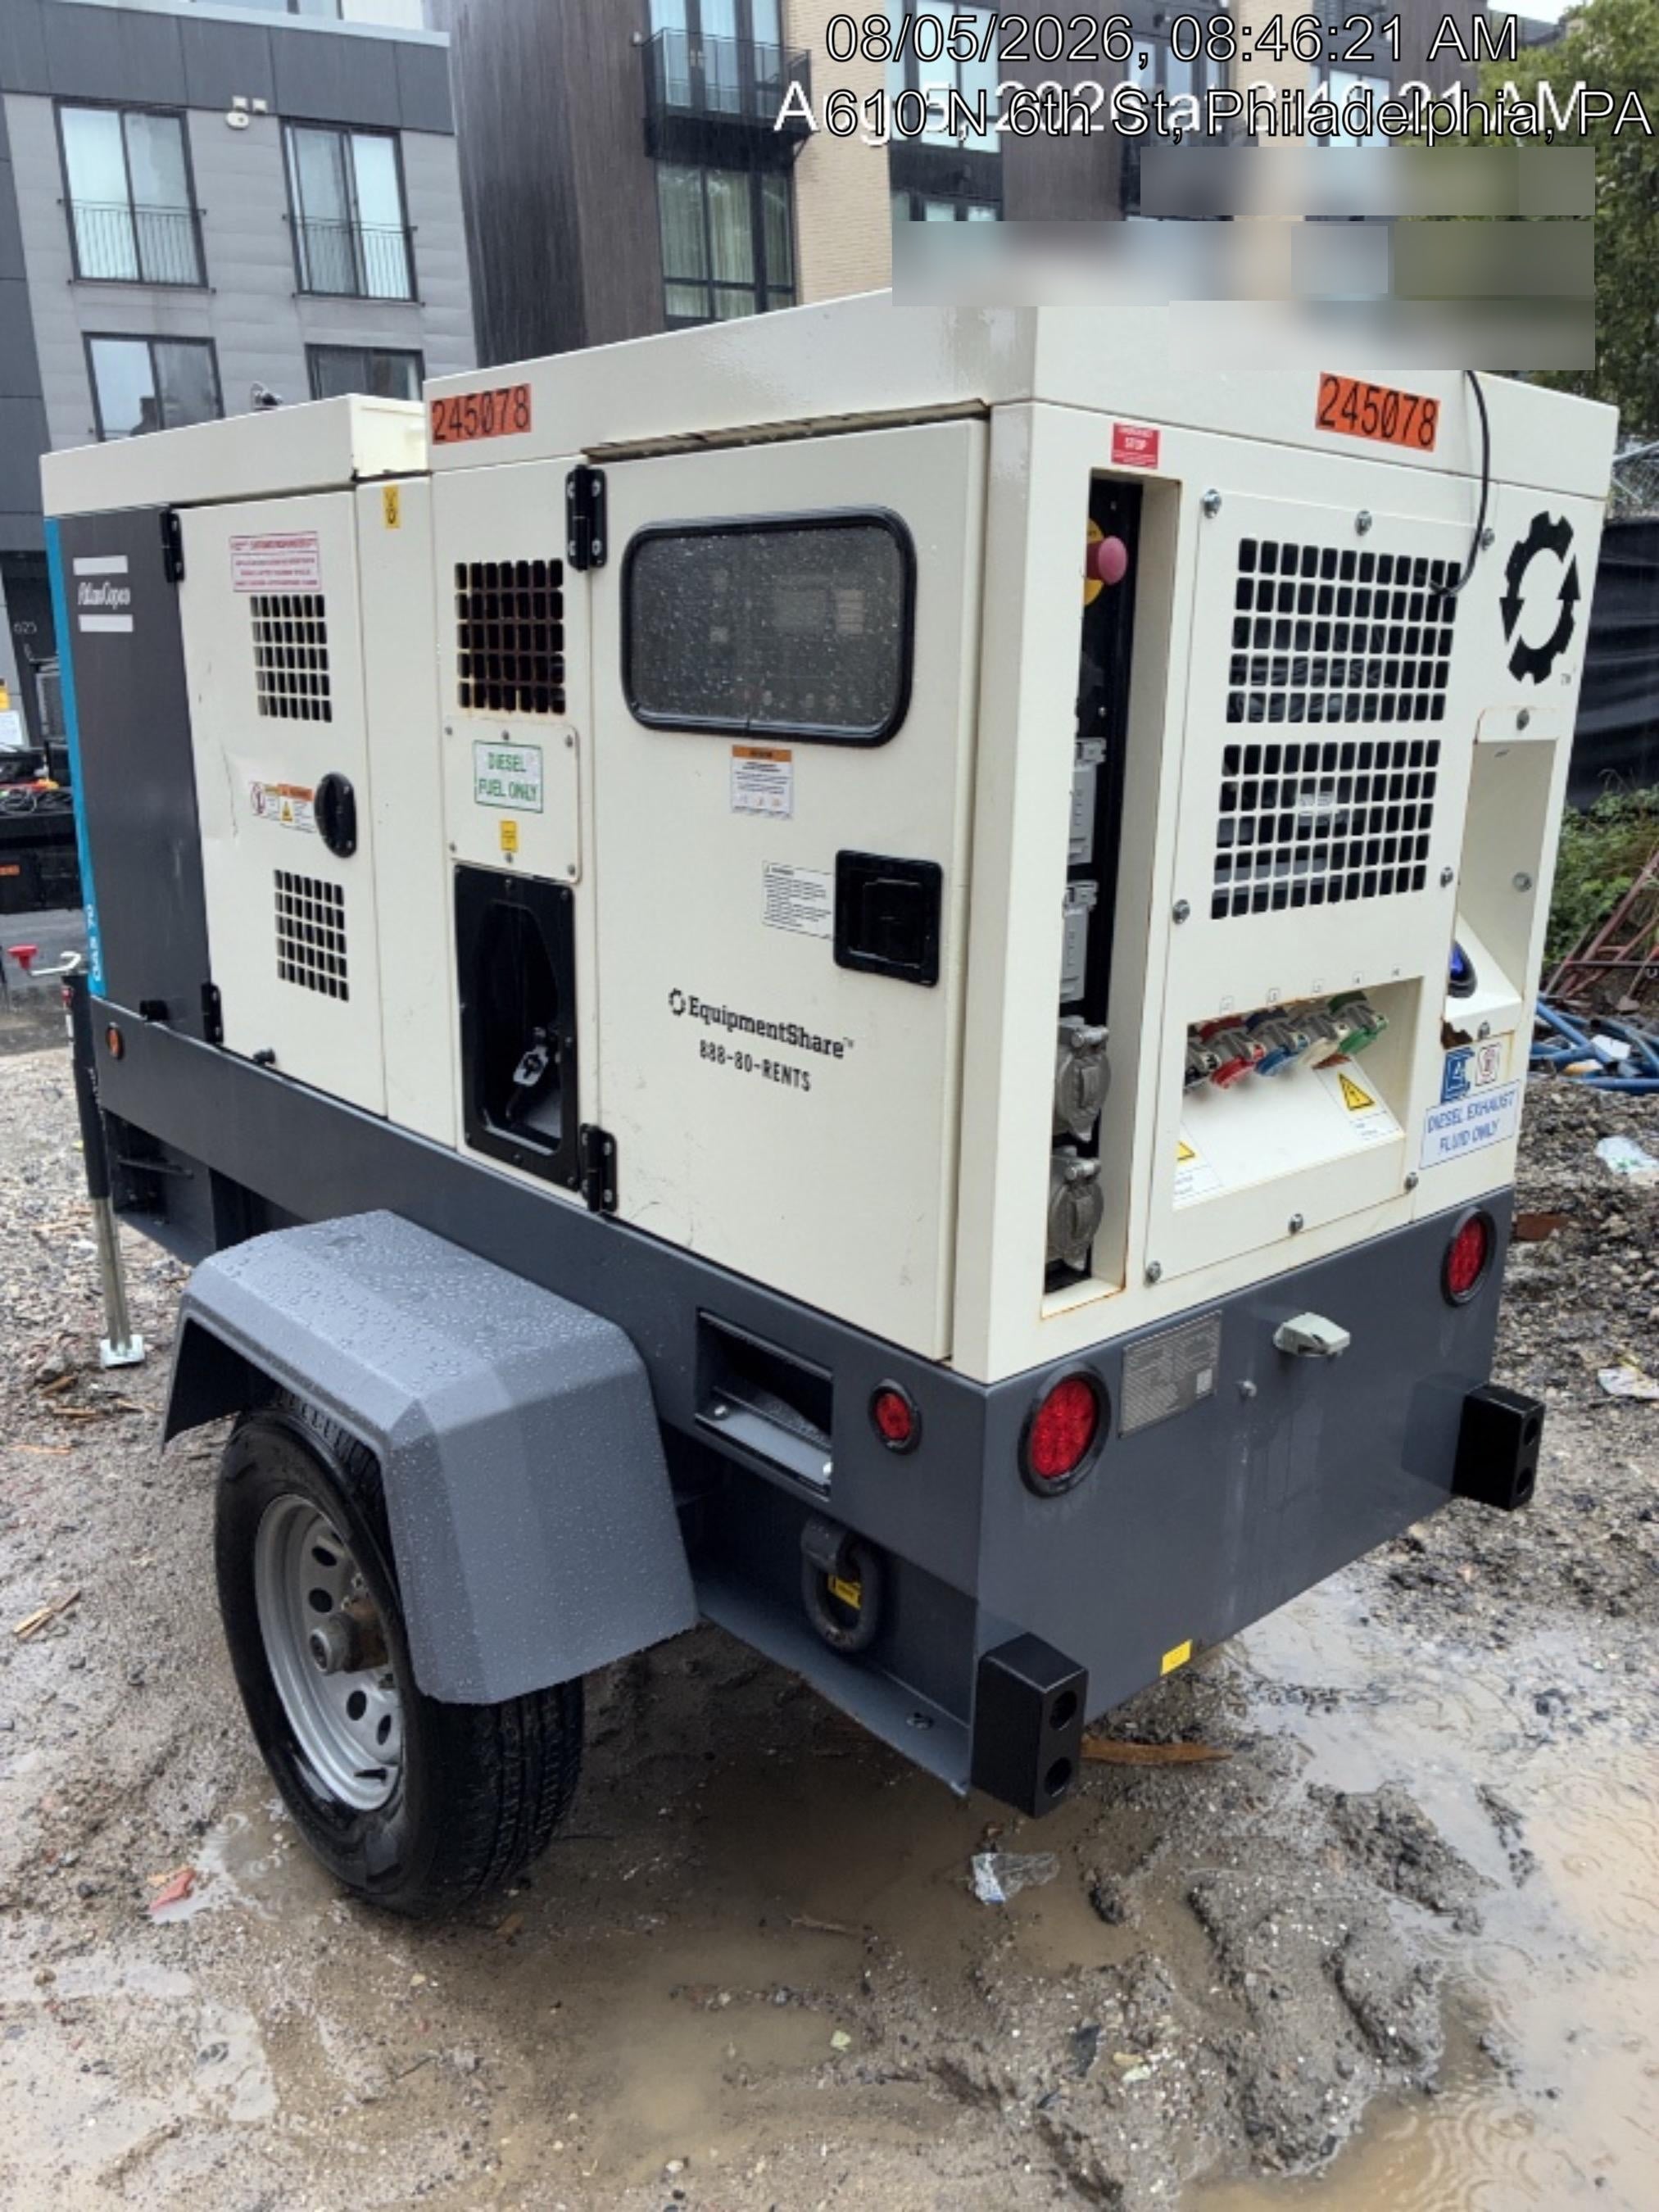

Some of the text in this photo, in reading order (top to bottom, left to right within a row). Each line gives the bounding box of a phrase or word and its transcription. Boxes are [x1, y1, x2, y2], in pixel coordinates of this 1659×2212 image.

[432, 385, 530, 441] 245078
[1319, 375, 1438, 446] 245078
[487, 752, 527, 773] DIESEL
[700, 1039, 811, 1092] 888-80-RENTS
